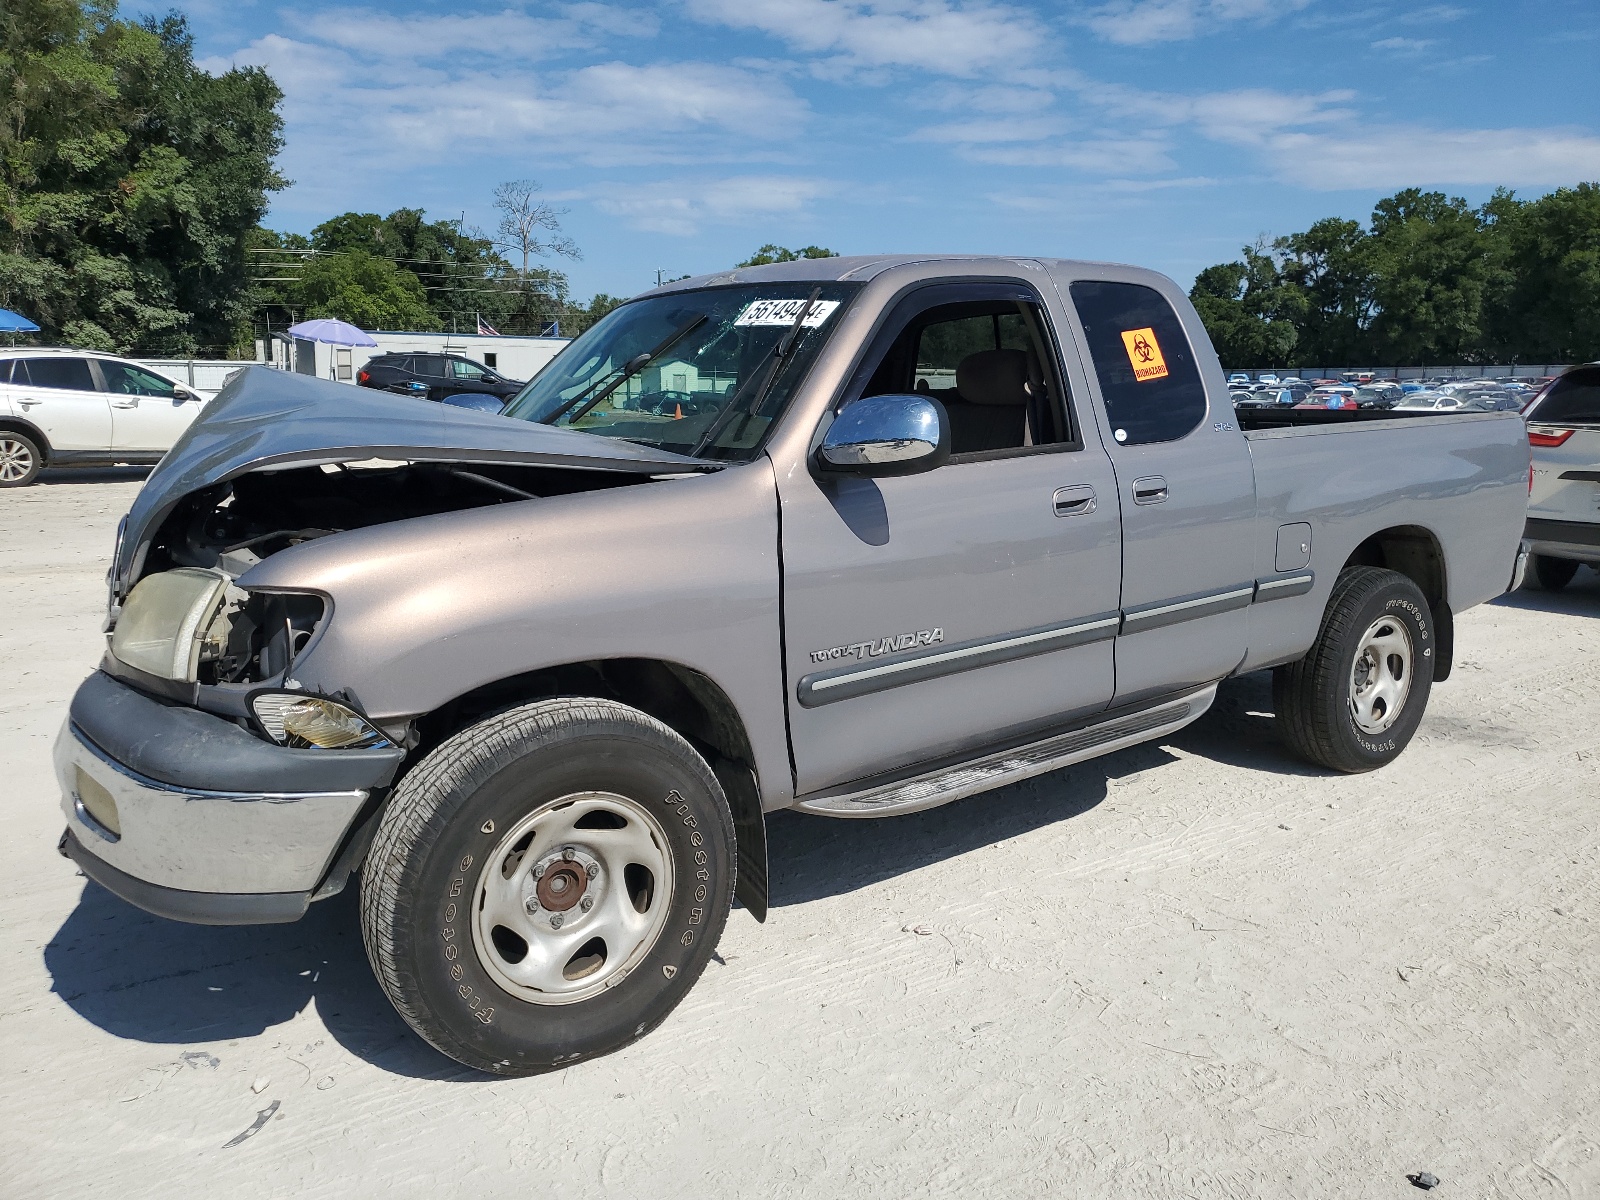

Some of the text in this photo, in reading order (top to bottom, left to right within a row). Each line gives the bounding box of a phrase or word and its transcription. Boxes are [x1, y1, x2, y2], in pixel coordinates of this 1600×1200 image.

[1135, 365, 1167, 379] BIOHAZARD
[810, 627, 945, 663] TOYOTA TUNDRA
[664, 789, 710, 947] Firestone
[440, 853, 495, 1025] Firestone
